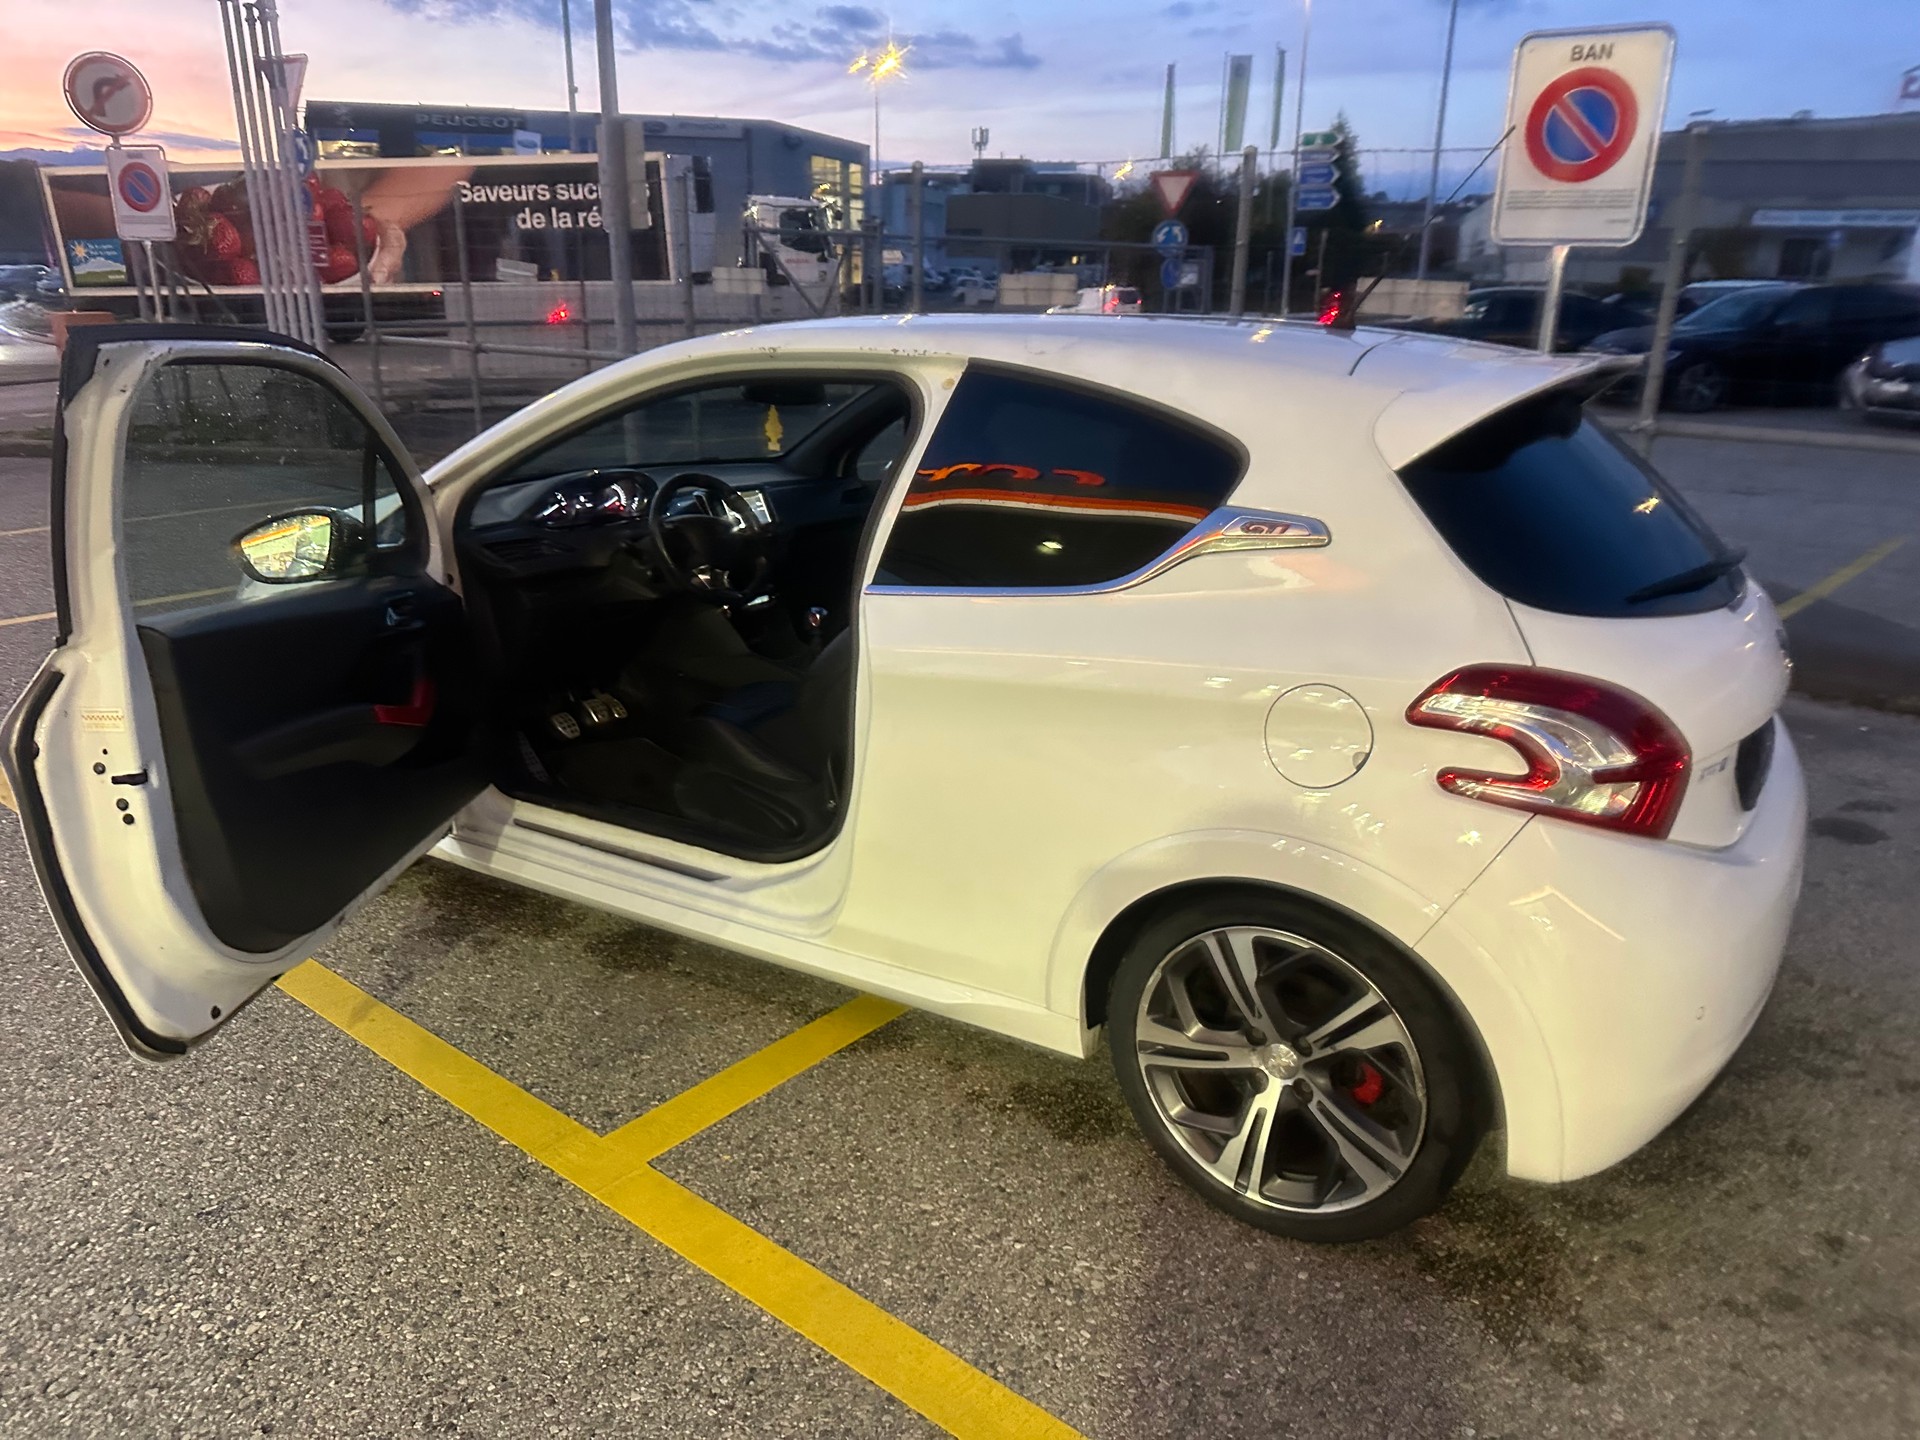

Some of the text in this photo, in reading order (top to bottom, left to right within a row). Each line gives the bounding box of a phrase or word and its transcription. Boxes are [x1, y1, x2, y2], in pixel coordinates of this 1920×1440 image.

[1570, 43, 1614, 61] BAN
[416, 113, 523, 128] PEUGEOT
[457, 181, 550, 202] Saveurs
[516, 207, 546, 229] de
[551, 207, 573, 229] la
